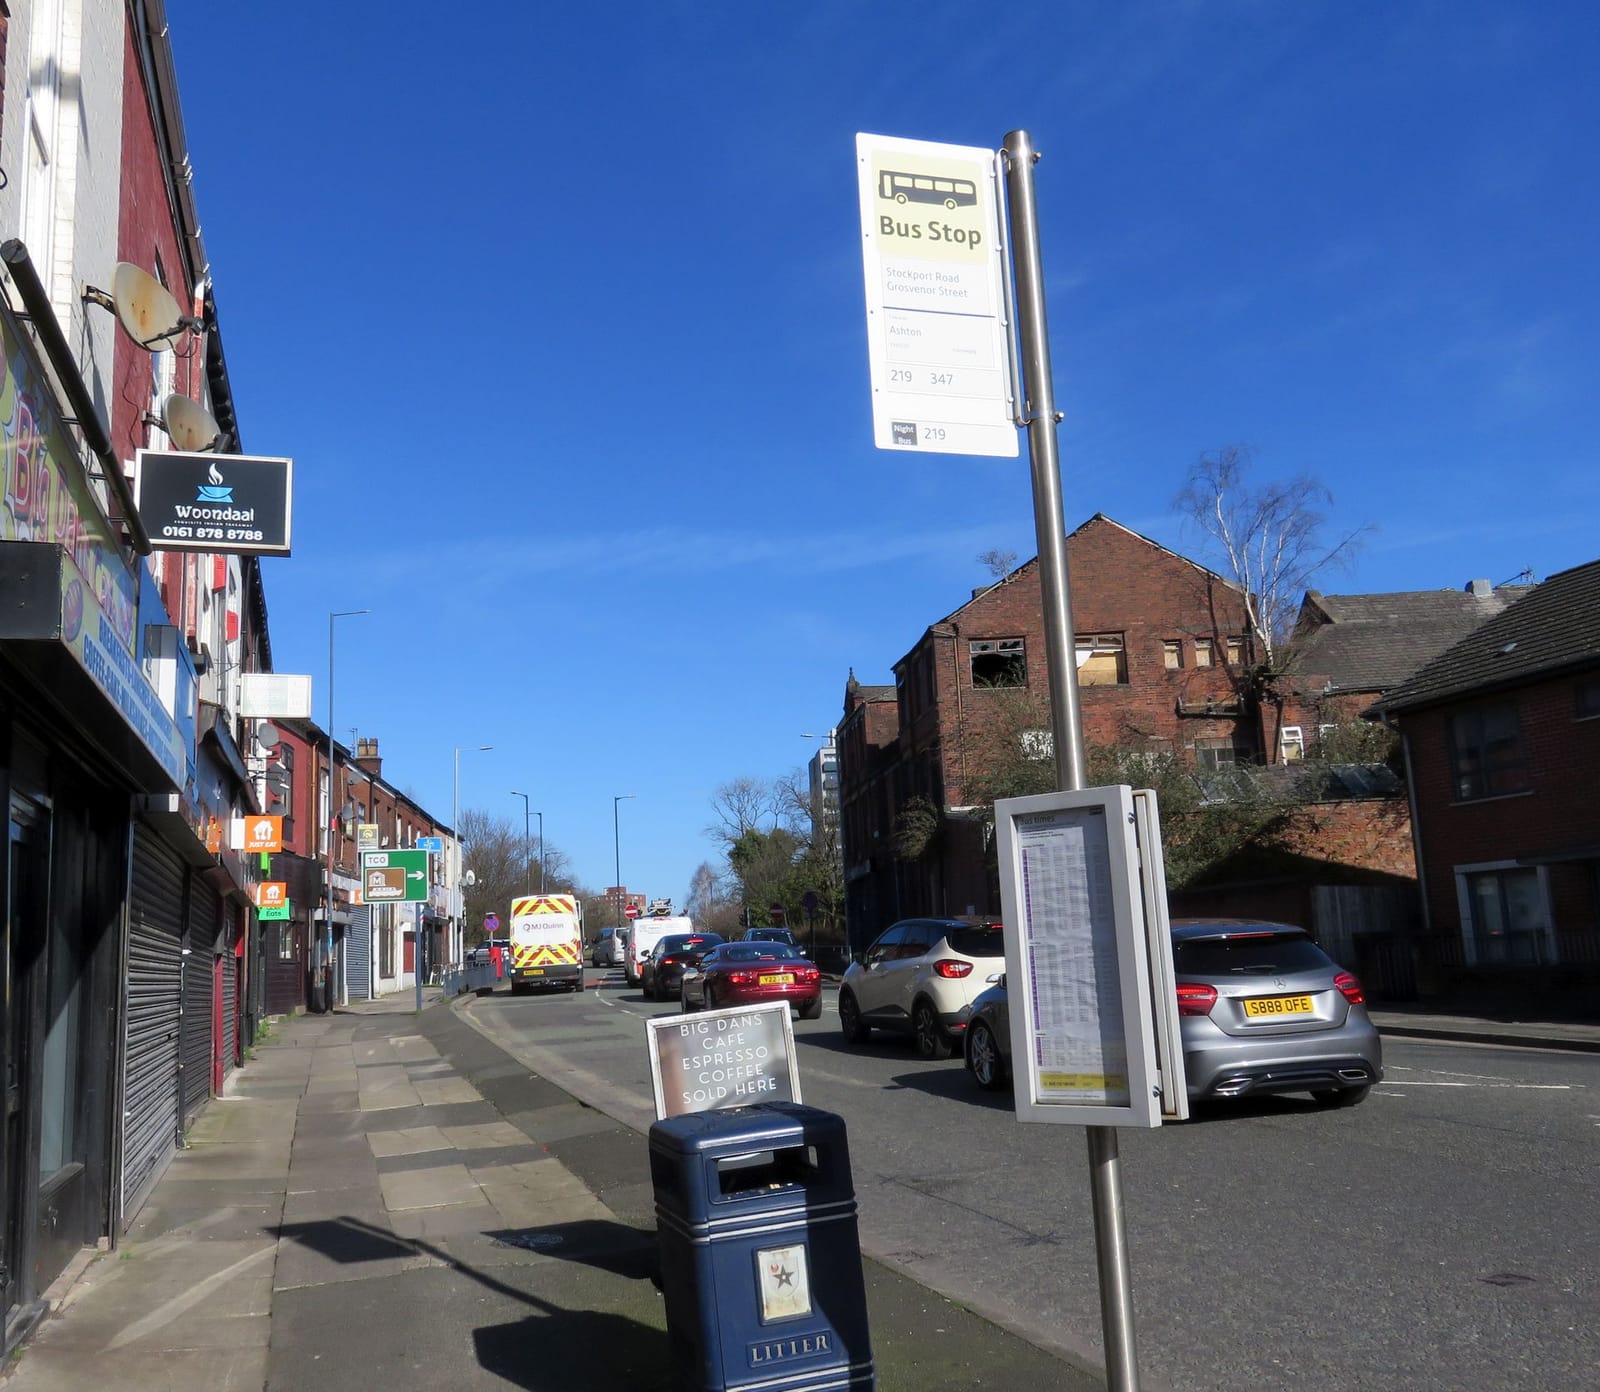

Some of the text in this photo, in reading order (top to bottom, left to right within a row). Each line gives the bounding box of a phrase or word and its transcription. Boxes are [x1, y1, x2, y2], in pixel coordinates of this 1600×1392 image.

[880, 215, 982, 250] Bus Stop
[886, 267, 960, 283] Stockport Road
[887, 281, 968, 298] Grosvenor Street
[889, 326, 922, 337] Ashton
[890, 370, 953, 385] 219 347
[894, 425, 914, 434] Night
[924, 428, 946, 440] 219
[174, 505, 254, 522] Woondaal
[163, 526, 263, 541] 0161 878 8788
[368, 856, 386, 864] TCO
[1250, 998, 1310, 1014] S888 OFE
[680, 1014, 763, 1037] BIG DANS
[702, 1032, 745, 1050] CAFE
[682, 1046, 768, 1070] ESPRESSO
[699, 1064, 764, 1084] COFFEE
[682, 1077, 777, 1104] SOLD HERE
[751, 1335, 829, 1362] LITTER
